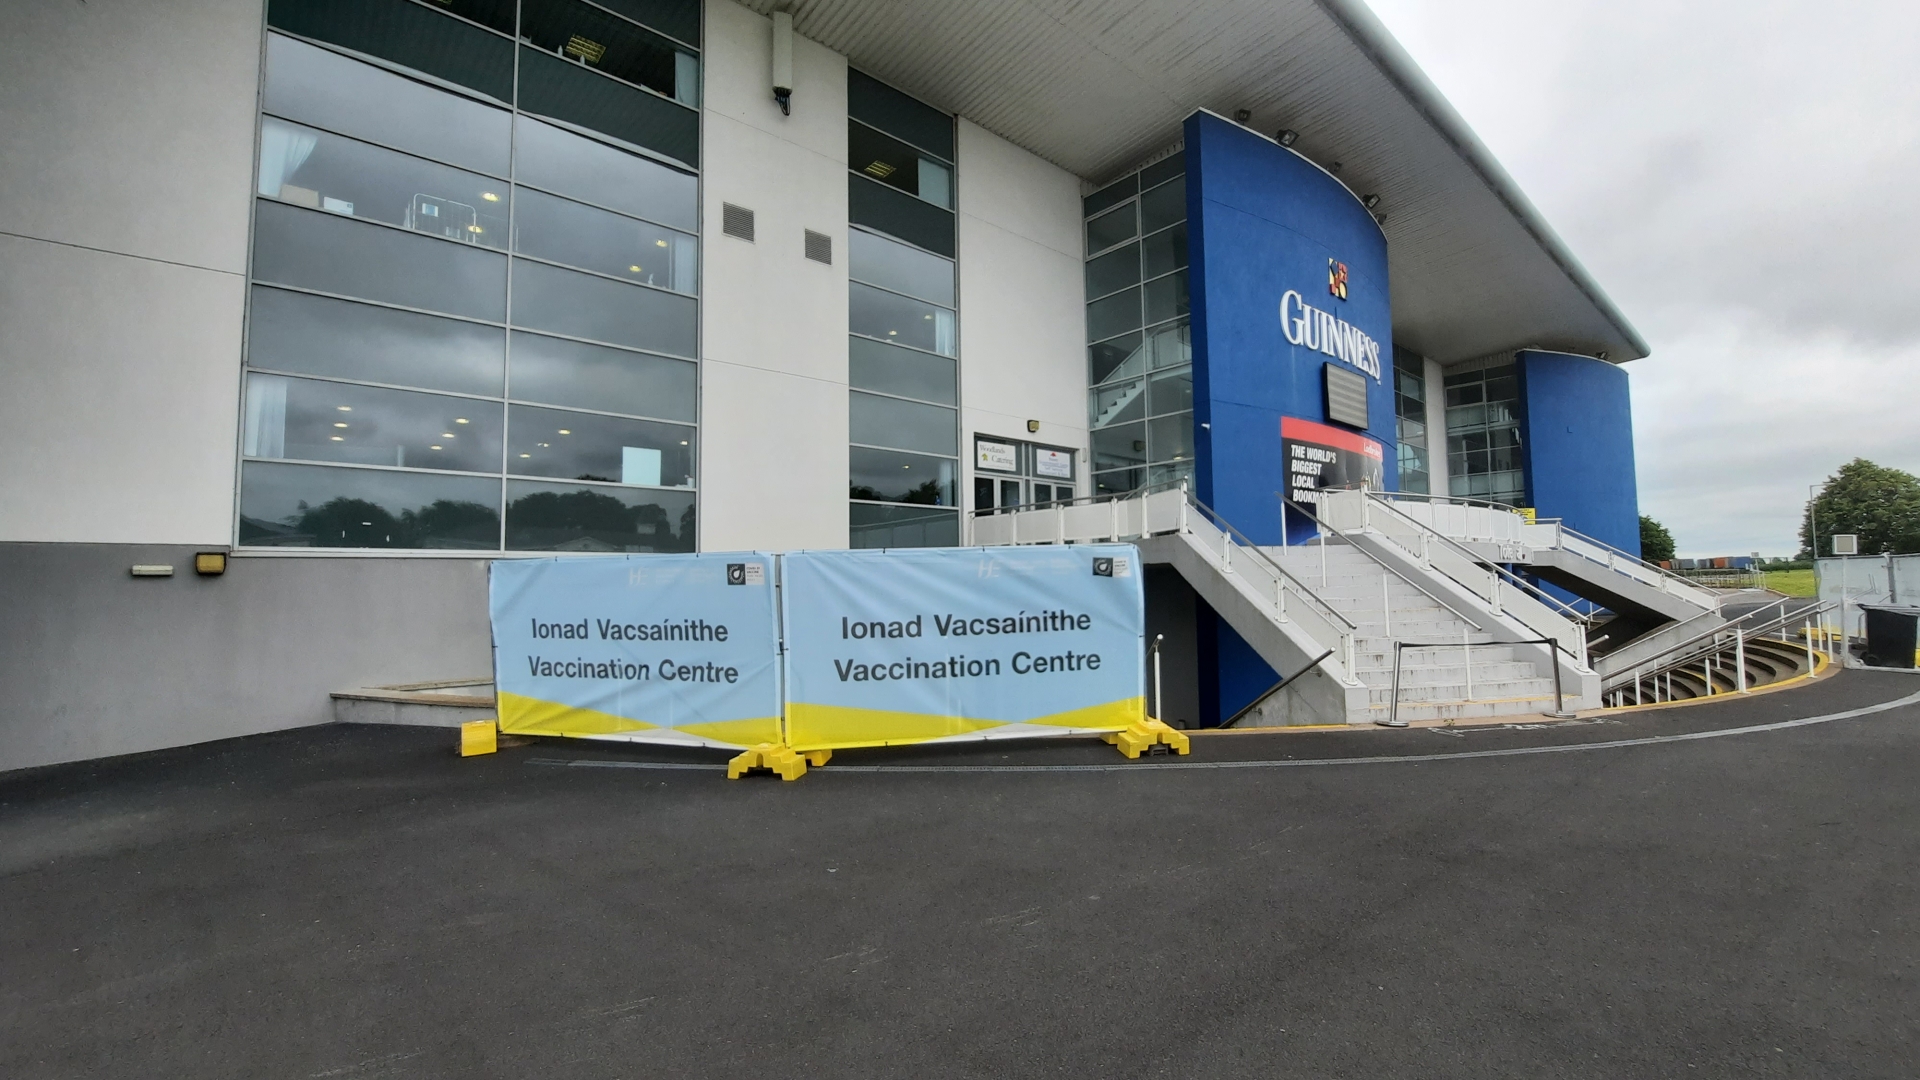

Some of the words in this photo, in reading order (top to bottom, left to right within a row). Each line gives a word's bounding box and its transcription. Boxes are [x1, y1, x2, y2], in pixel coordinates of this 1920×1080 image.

[1280, 289, 1380, 380] GUINNESS
[1291, 444, 1306, 458] THE
[1306, 446, 1337, 464] WORLD'S
[1291, 459, 1322, 475] BIGGEST
[1292, 474, 1315, 489] LOCAL
[531, 617, 589, 639] Ionad
[597, 618, 729, 642] Vacsaínithe
[841, 614, 922, 640] Ionad
[933, 609, 1091, 637] Vacsaínithe
[527, 655, 650, 681] Vaccination
[658, 658, 739, 684] Centre
[833, 654, 1001, 682] Vaccination
[1011, 649, 1102, 675] Centre
